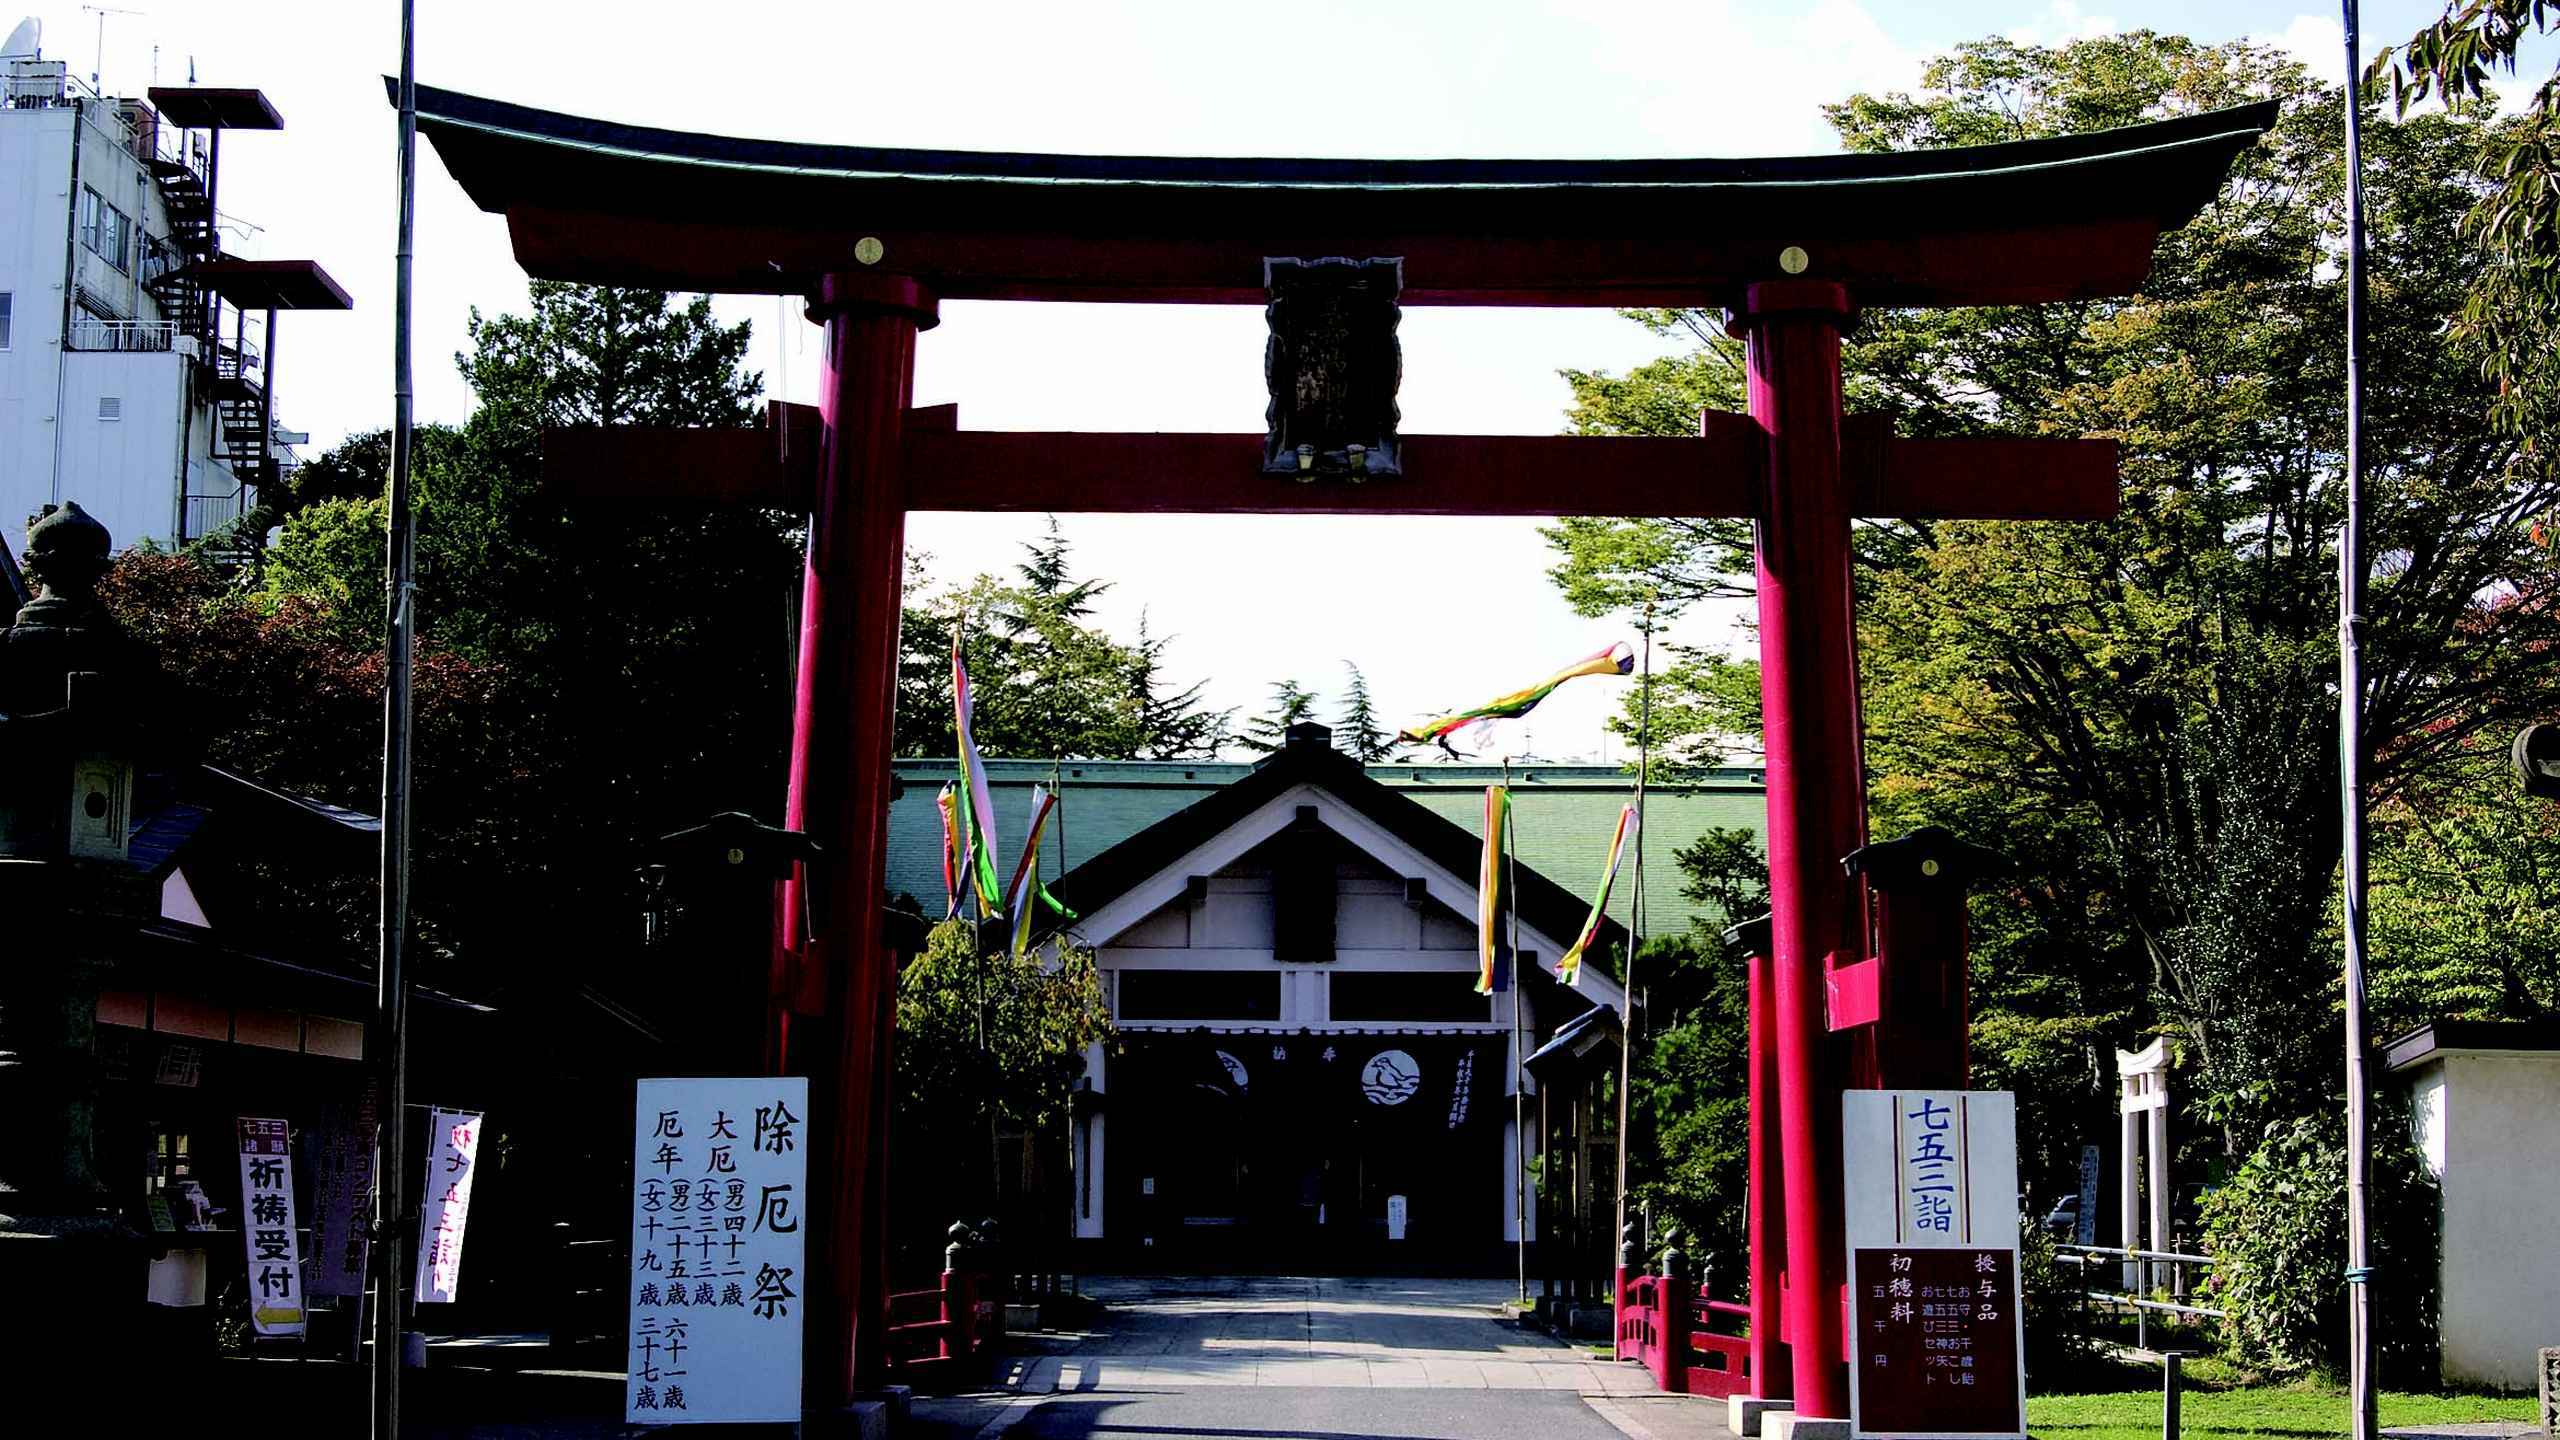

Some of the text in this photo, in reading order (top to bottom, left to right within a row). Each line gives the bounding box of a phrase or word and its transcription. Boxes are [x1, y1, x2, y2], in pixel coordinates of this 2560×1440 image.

[244, 1121, 285, 1135] 七五三
[652, 1111, 683, 1175] 厄年
[707, 1111, 737, 1173] 大厄
[1908, 1099, 1955, 1233] 七五三詣
[248, 1157, 295, 1298] 祈祷受付
[750, 1101, 800, 1321] 除厄祭
[1889, 1254, 1915, 1323] 初穂料
[1975, 1254, 1999, 1320] 授与品
[1873, 1286, 1888, 1367] 五千円
[1946, 1286, 1961, 1385] 七五三おこし
